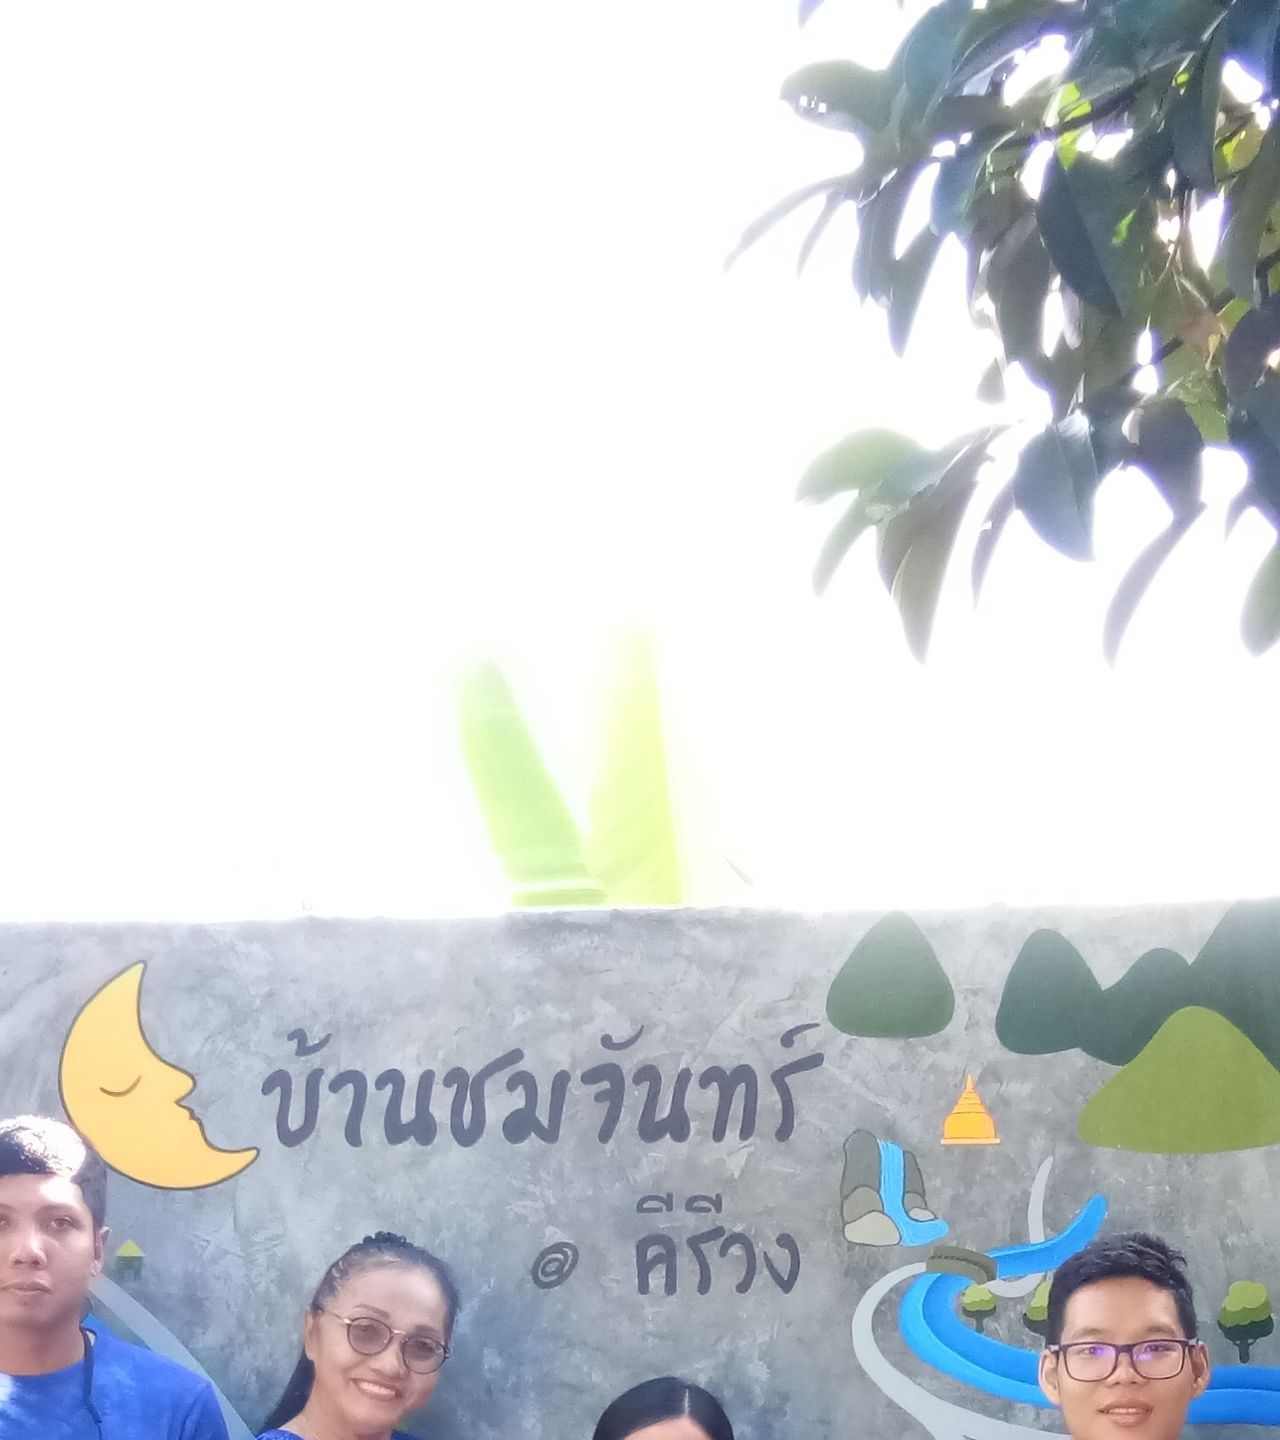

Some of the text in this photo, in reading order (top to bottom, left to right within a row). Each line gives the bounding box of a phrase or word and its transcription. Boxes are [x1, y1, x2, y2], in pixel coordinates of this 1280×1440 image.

[261, 1024, 825, 1148] บ้านชมจันทร์
[530, 1192, 802, 1296] @ คีรีวง
